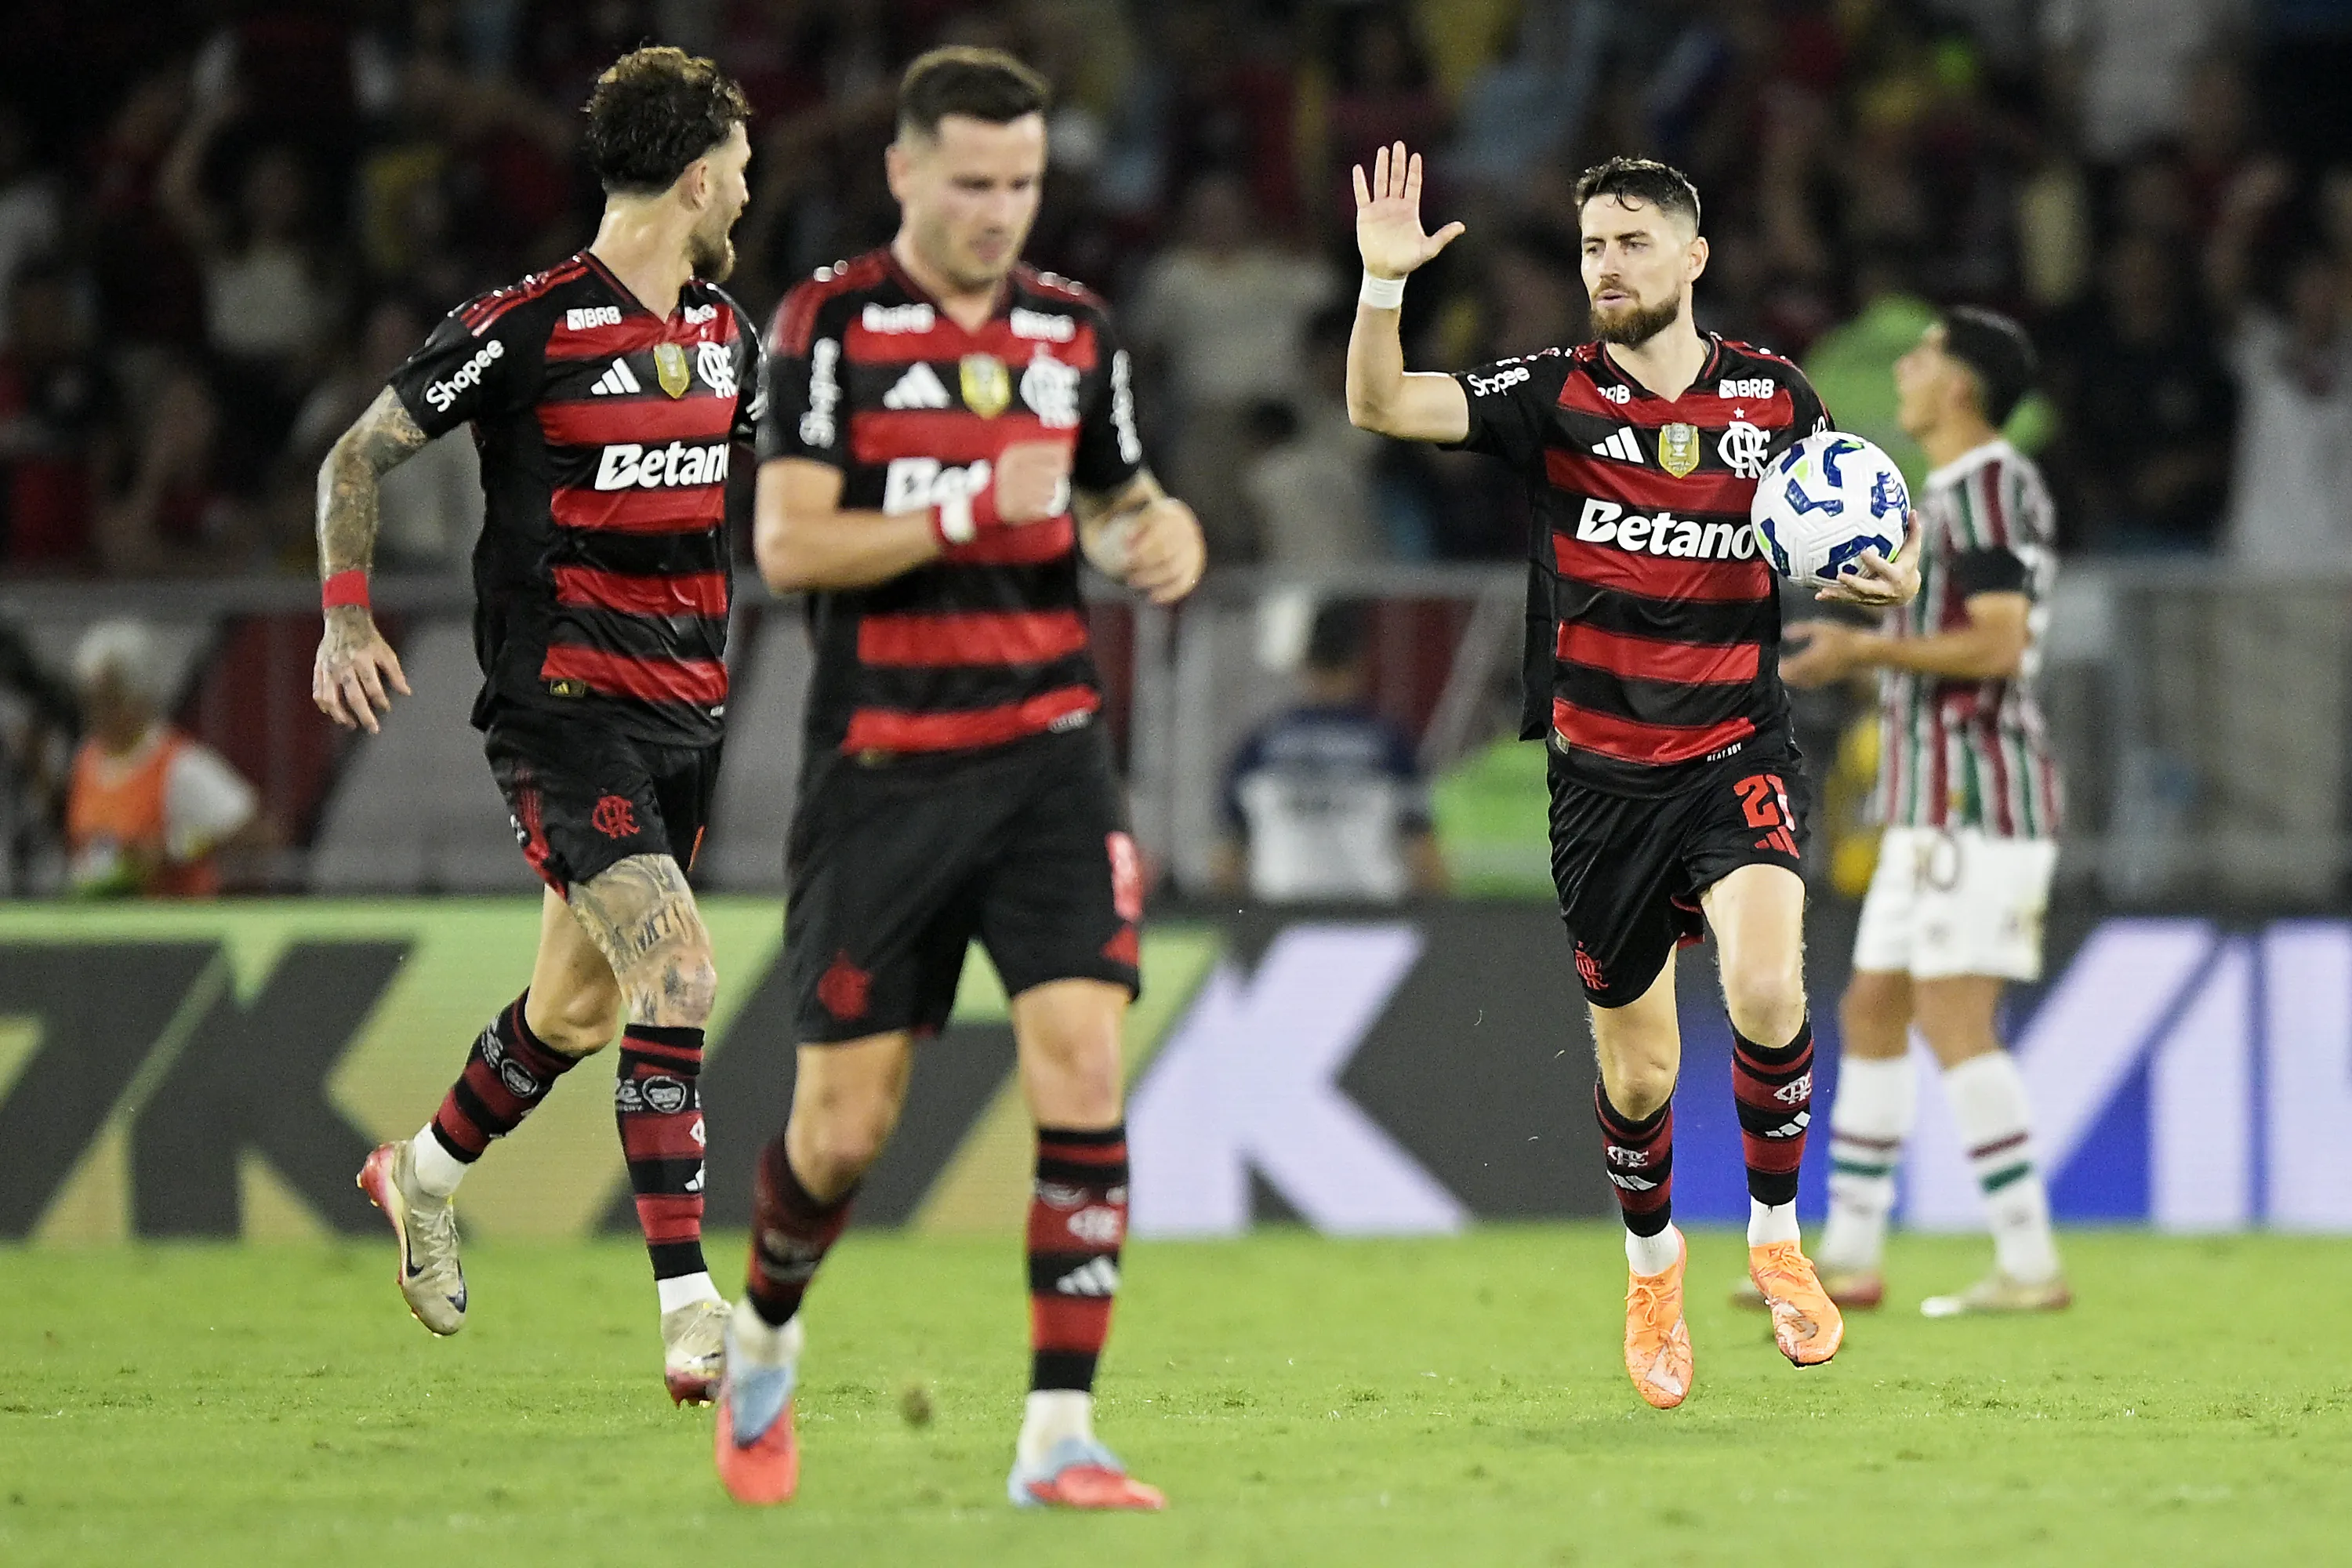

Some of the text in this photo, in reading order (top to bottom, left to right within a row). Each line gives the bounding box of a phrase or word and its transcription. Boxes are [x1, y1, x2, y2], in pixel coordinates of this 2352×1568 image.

[584, 306, 622, 328] BRB
[426, 339, 506, 412] Shopee
[1737, 378, 1775, 399] BRB
[1576, 497, 1755, 560] Betano
